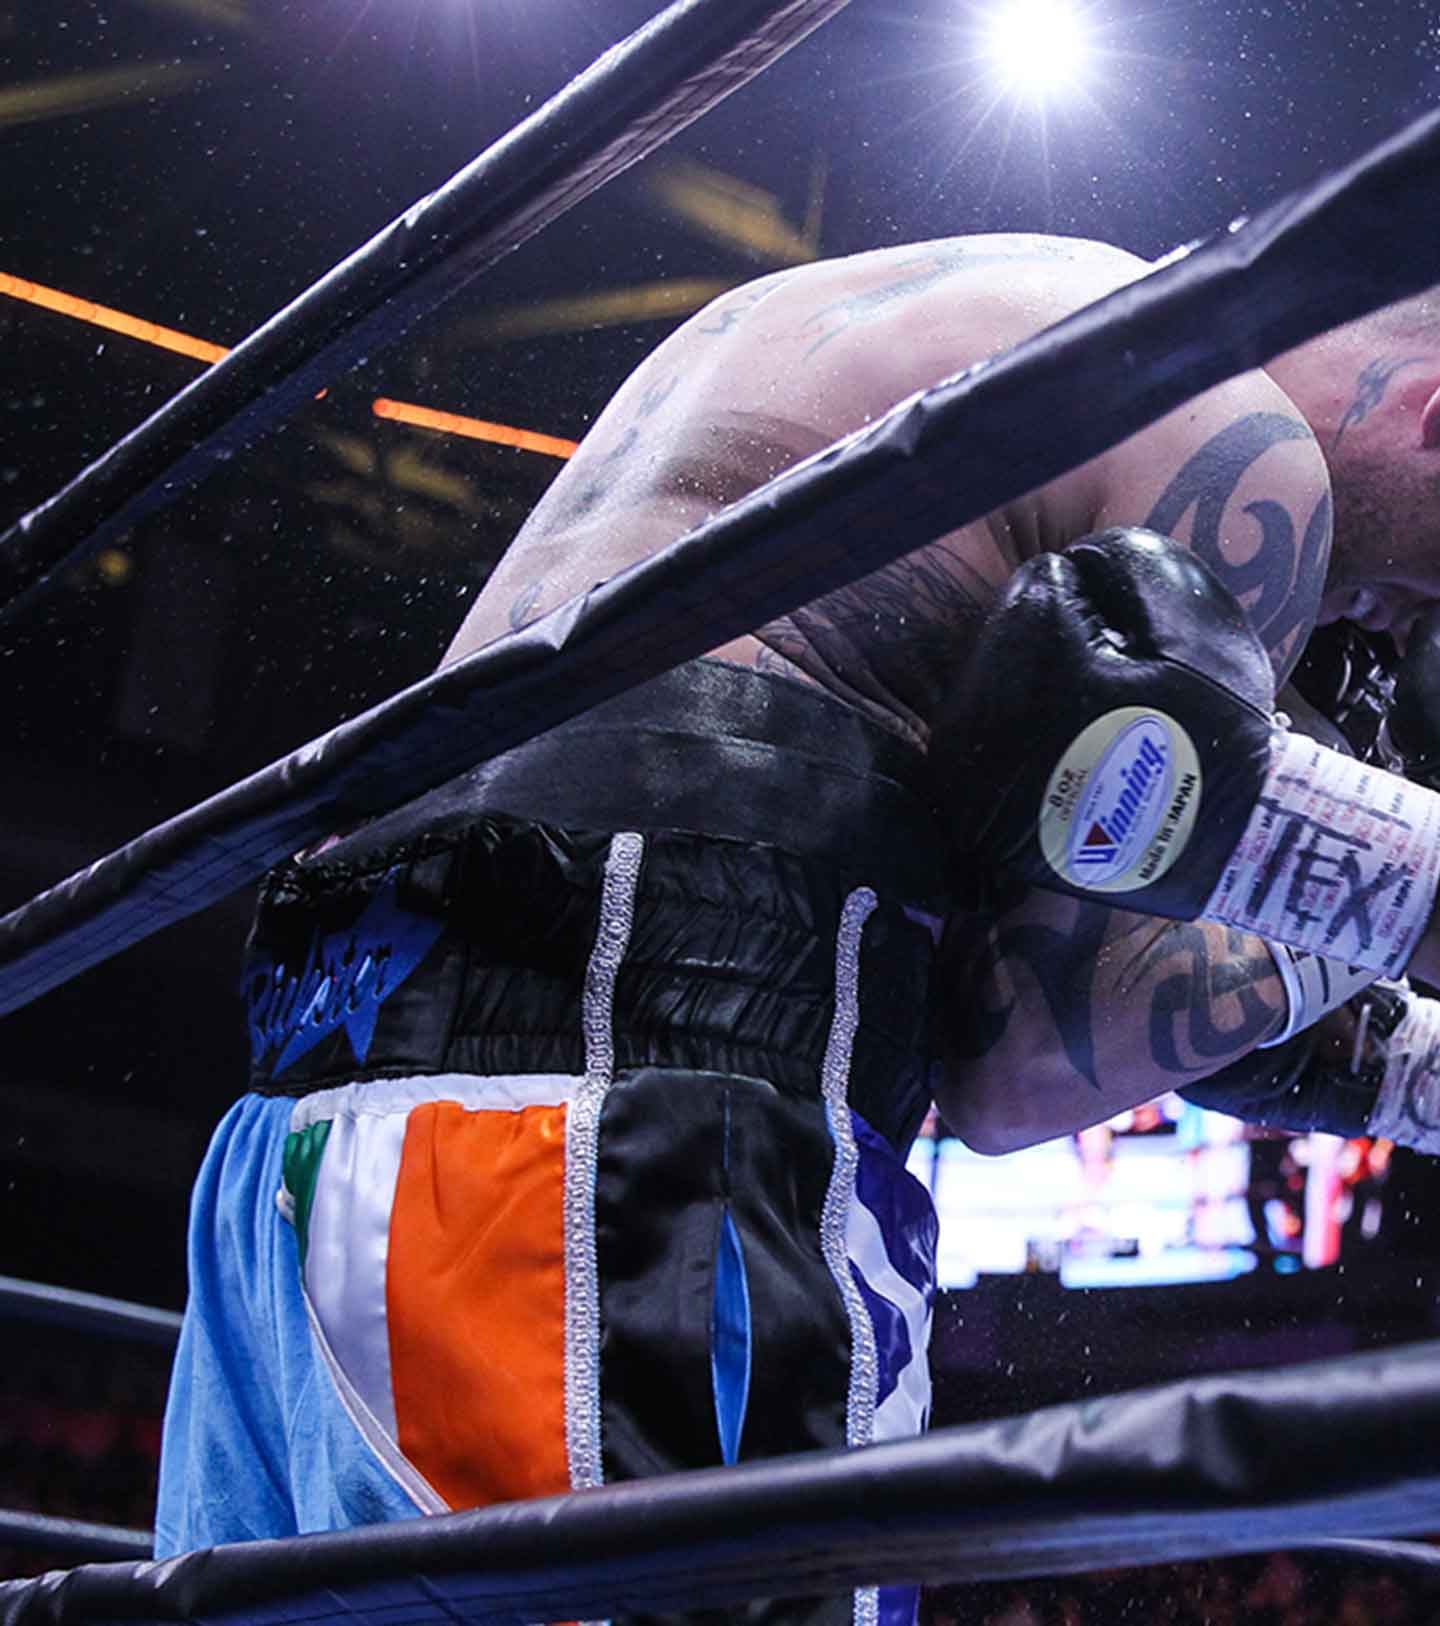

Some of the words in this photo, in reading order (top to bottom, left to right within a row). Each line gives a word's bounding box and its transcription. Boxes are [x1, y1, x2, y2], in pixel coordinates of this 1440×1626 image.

[1073, 736, 1167, 864] Winning
[1138, 844, 1166, 880] Made
[1167, 773, 1197, 822] JAPAN
